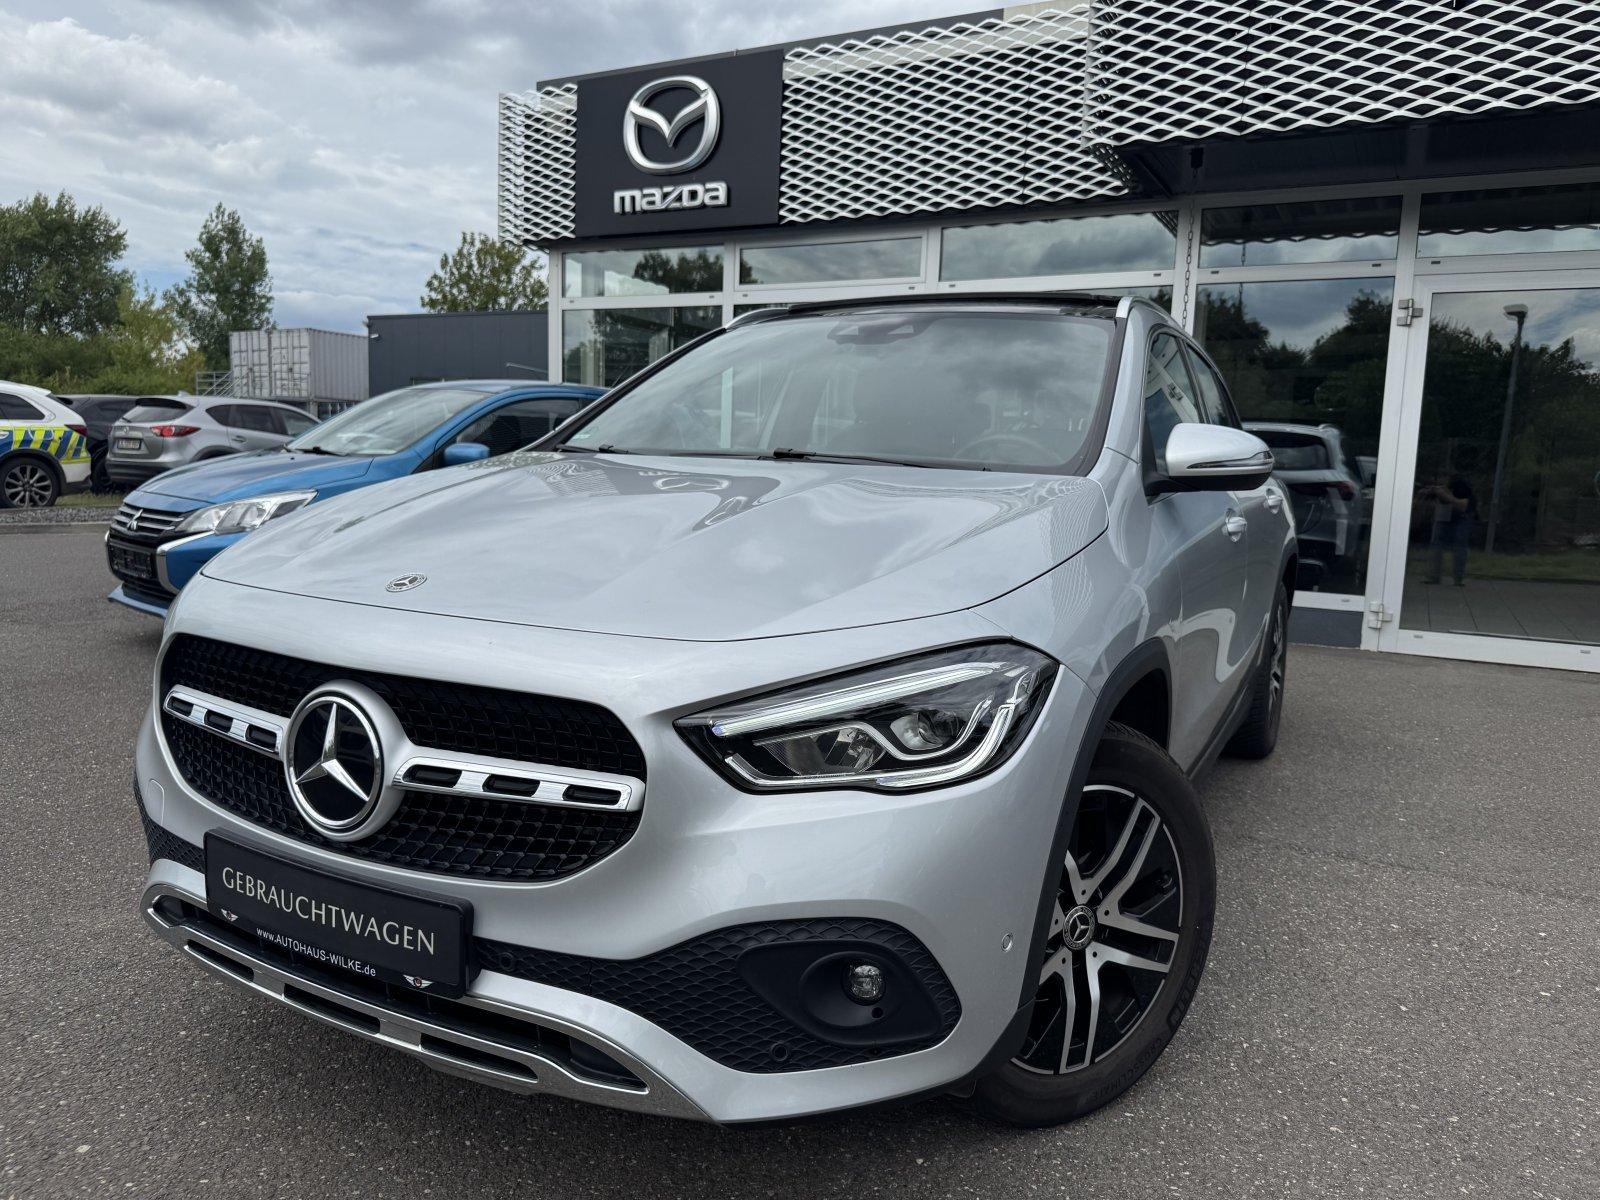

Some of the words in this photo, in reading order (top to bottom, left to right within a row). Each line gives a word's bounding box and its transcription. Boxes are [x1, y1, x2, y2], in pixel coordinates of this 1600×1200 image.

[613, 181, 728, 214] mazda
[222, 866, 436, 955] GEBRAUCHTWAGEN
[256, 927, 377, 977] www.AUTOHAUS-WILKE.de
